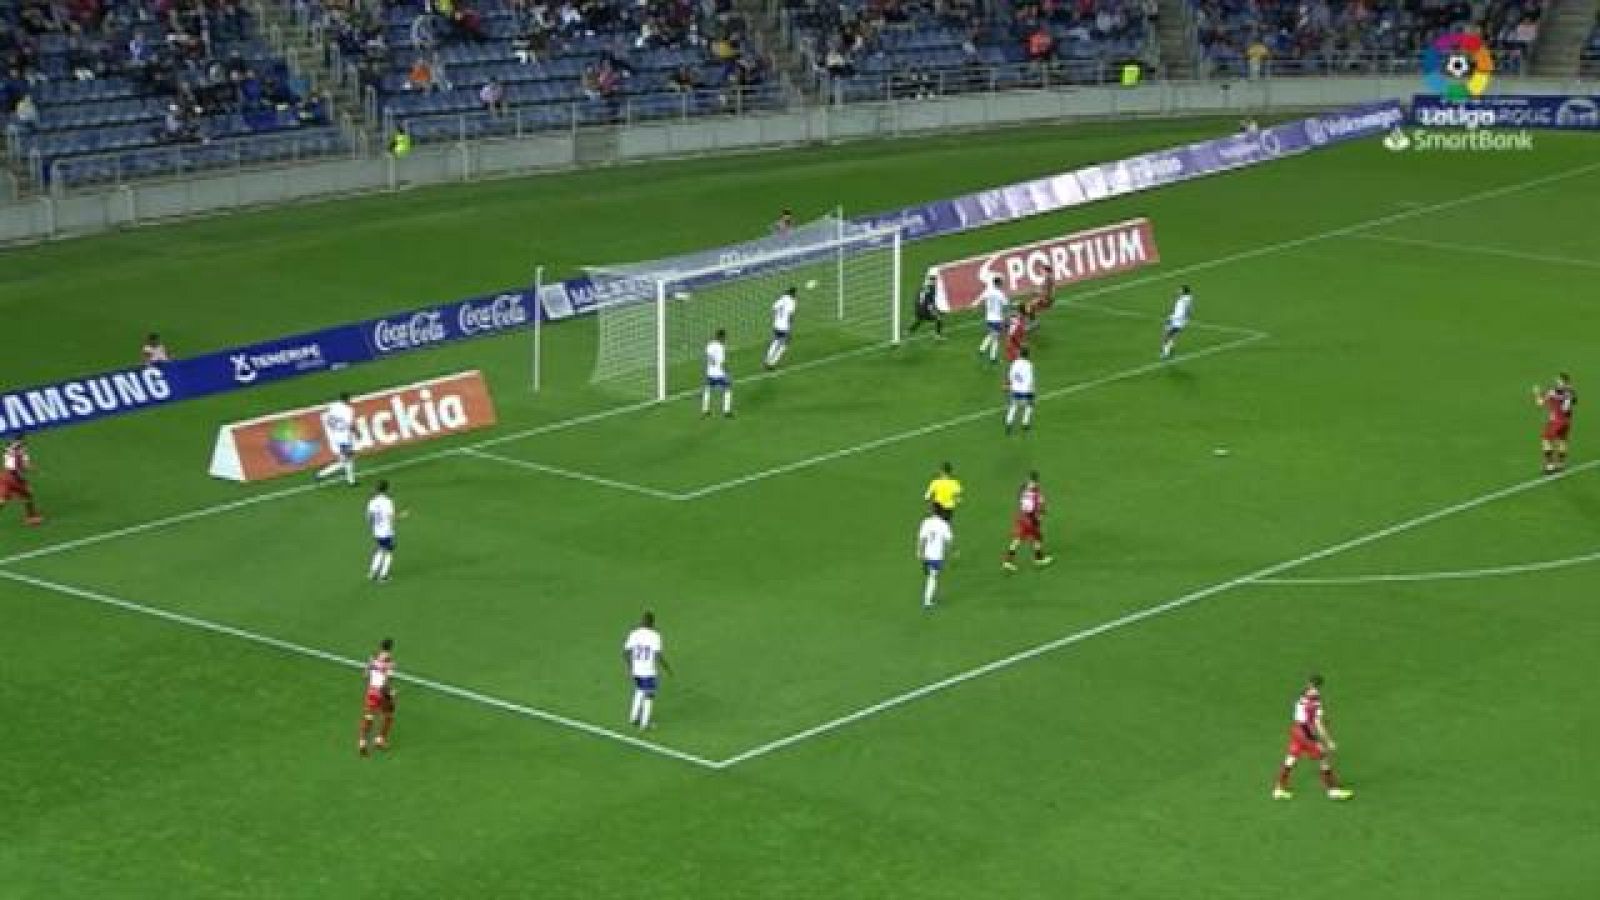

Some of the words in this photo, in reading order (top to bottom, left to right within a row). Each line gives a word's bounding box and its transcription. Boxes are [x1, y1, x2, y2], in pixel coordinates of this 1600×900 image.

[979, 227, 1147, 293] SPORTIUM
[0, 366, 171, 433] AMSUNG
[348, 389, 468, 452] uckia
